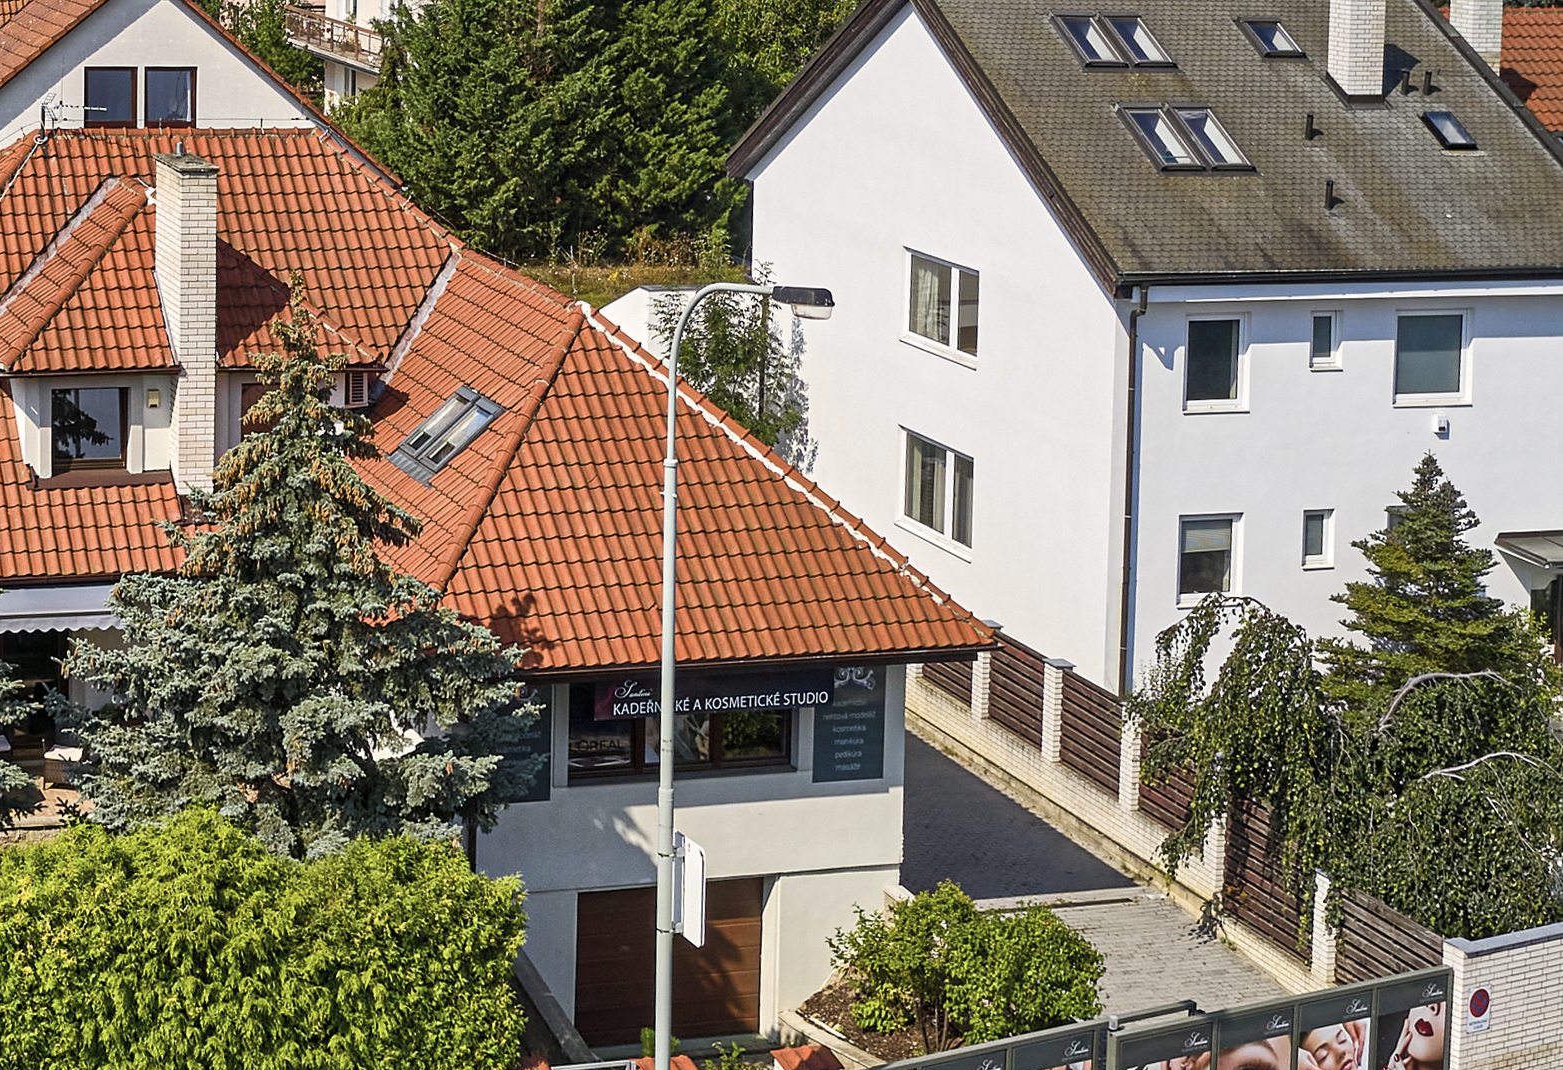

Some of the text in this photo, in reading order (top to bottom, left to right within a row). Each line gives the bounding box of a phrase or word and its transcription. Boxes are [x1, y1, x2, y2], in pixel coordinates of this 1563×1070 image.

[613, 691, 829, 716] KADEŘNKÉ A KOSMETICKÉ STUDIO
